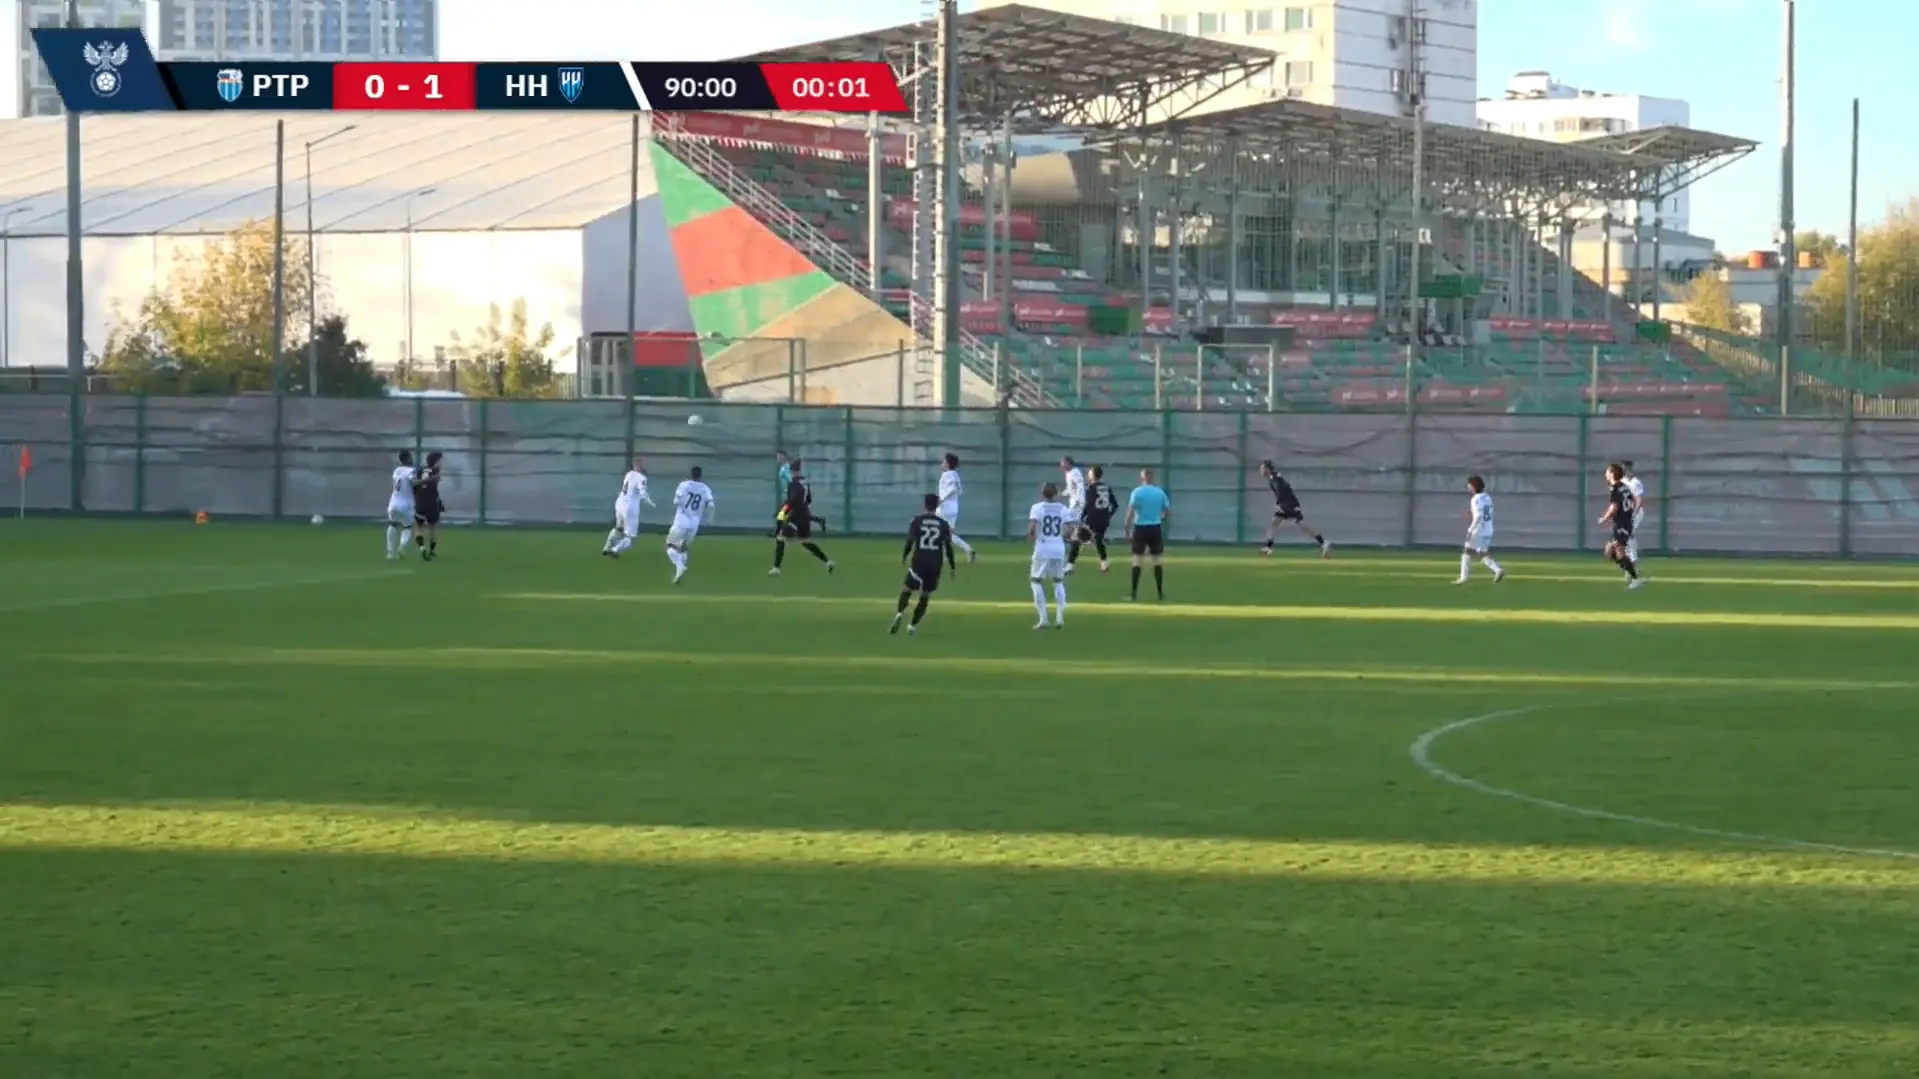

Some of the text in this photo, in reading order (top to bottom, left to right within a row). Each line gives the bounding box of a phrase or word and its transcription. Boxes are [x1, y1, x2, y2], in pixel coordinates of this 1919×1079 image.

[685, 492, 702, 511] 78
[1042, 514, 1062, 537] 83
[920, 526, 940, 550] 22
